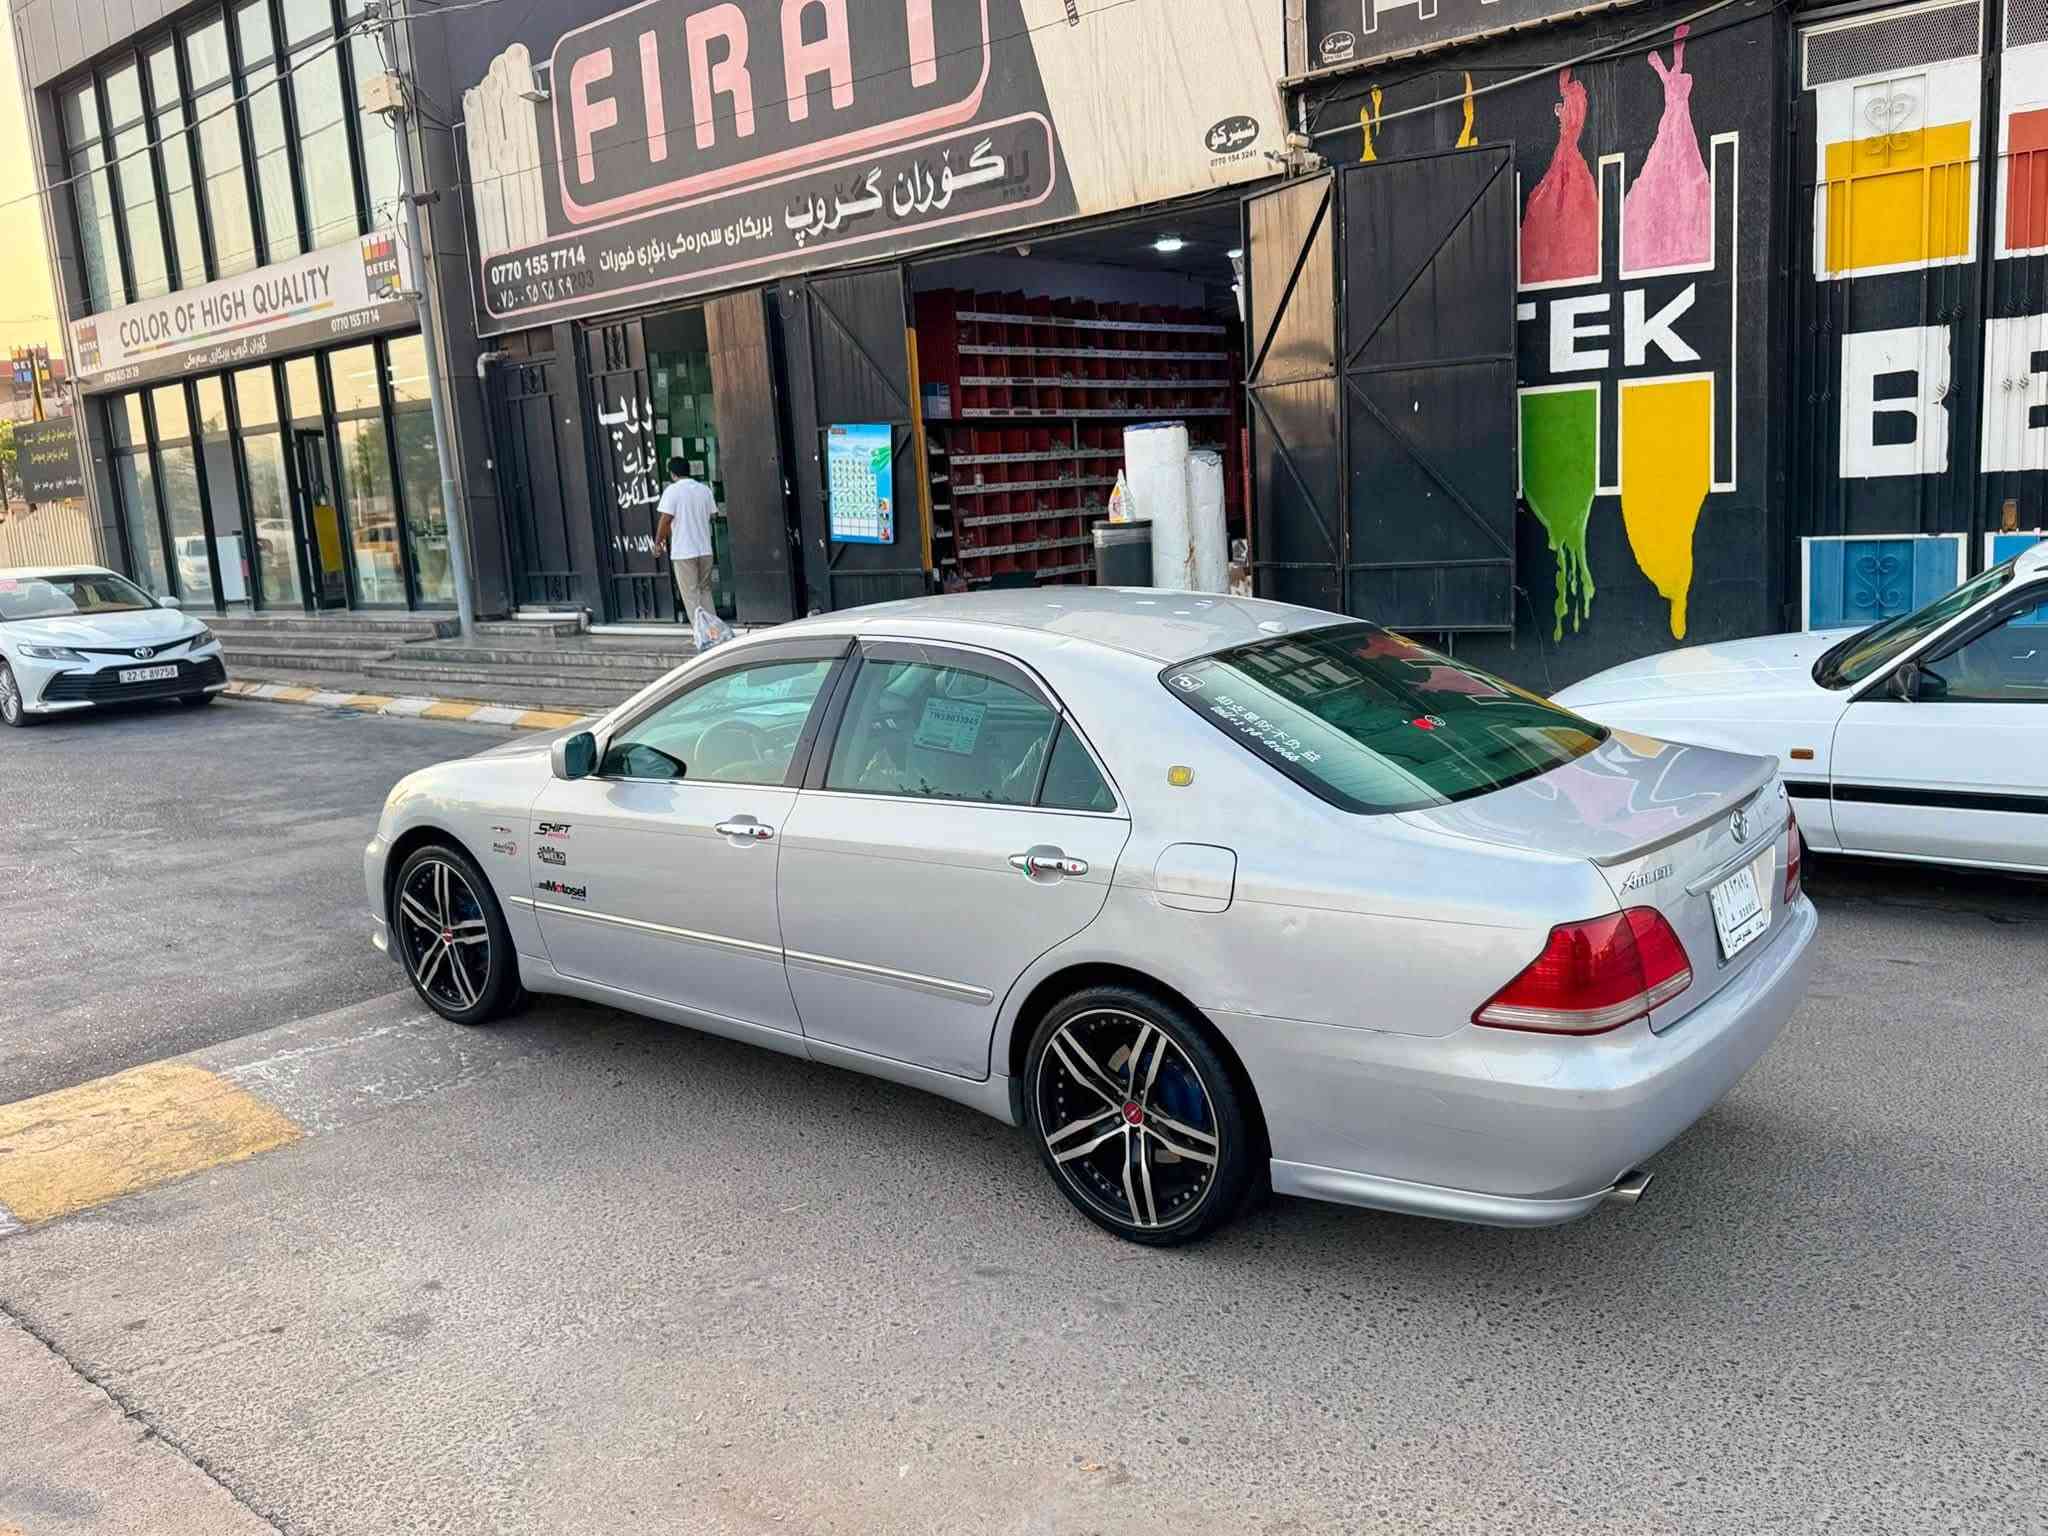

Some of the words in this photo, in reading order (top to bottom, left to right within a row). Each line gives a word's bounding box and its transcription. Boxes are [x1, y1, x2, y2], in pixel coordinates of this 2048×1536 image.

[892, 137, 1005, 217] گۆران
[785, 165, 884, 249] گروپ
[366, 259, 398, 276] BETEK
[491, 259, 522, 286] 0770
[525, 253, 549, 276] 155
[551, 244, 586, 270] 7714
[119, 313, 170, 348] COLOR
[174, 305, 196, 334] OF
[201, 289, 246, 328] HIGH
[253, 264, 330, 310] QUALITY
[12, 359, 48, 371] BETK
[534, 822, 572, 834] SHIFT
